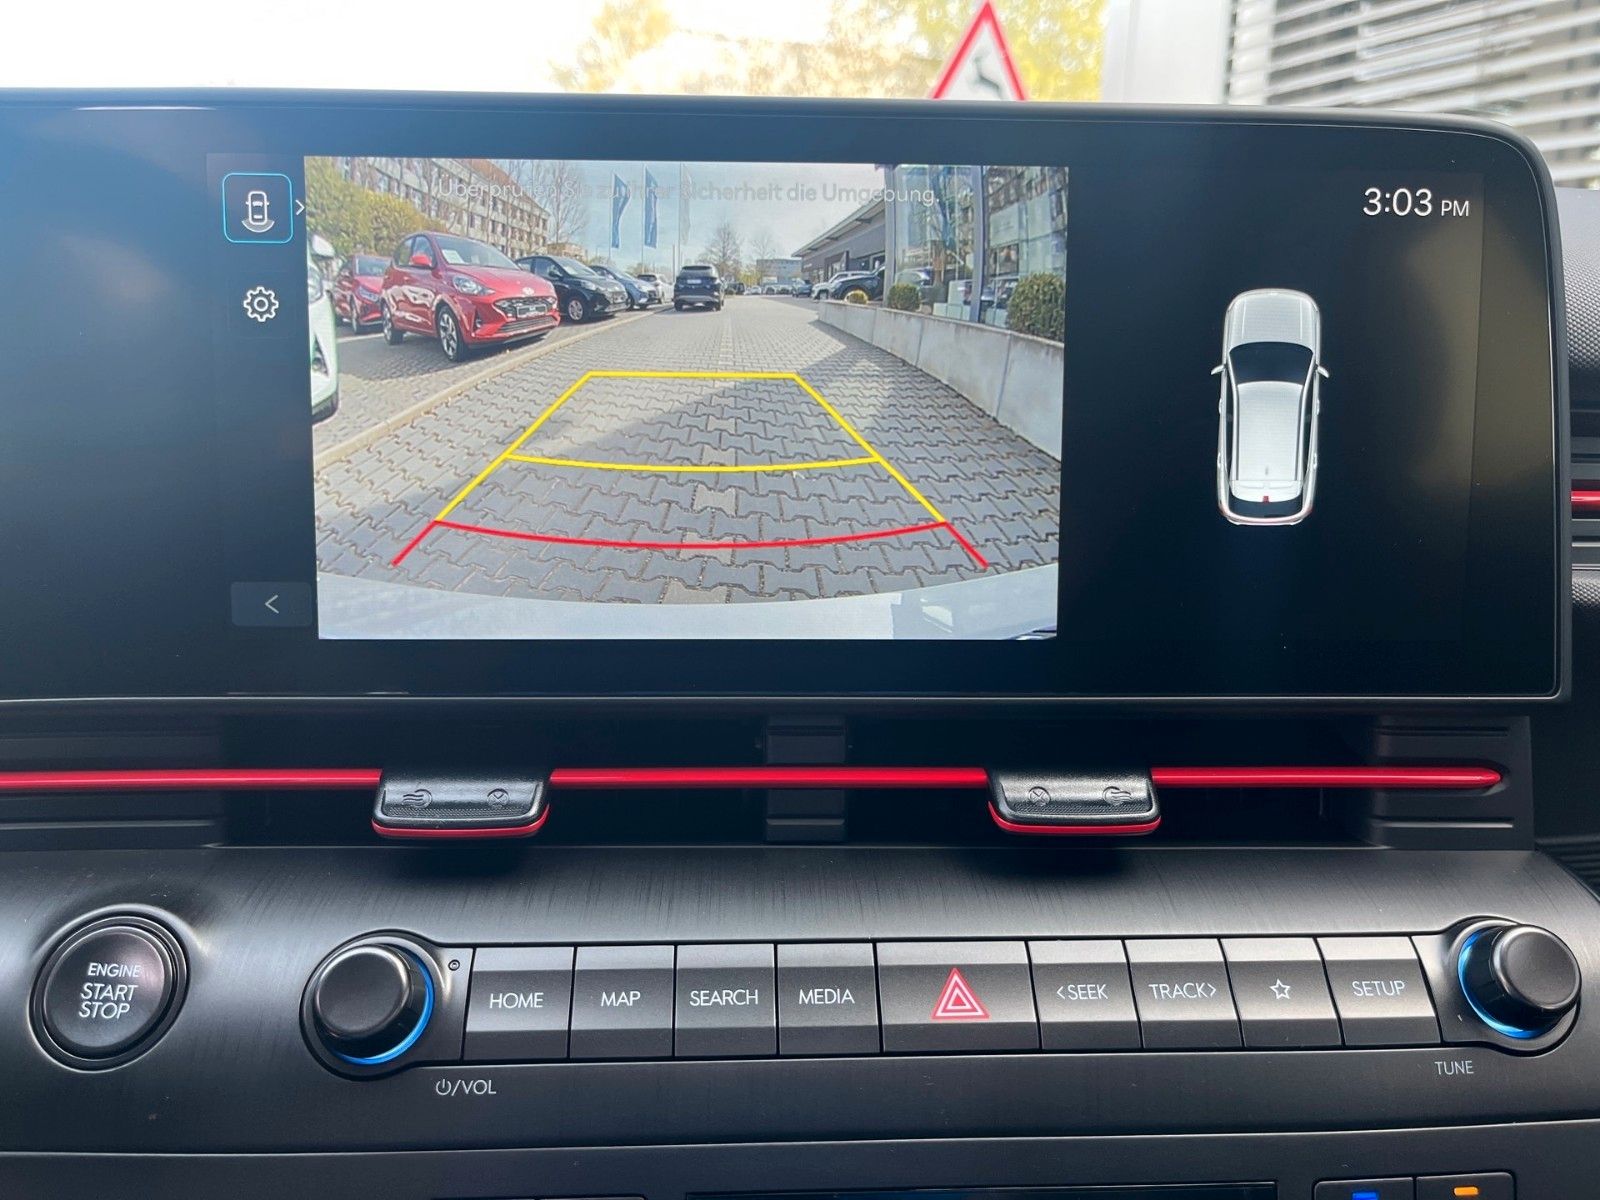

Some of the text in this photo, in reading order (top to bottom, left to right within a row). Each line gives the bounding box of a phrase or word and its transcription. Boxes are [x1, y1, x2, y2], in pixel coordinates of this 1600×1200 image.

[786, 182, 817, 201] die
[1363, 187, 1470, 217] 3:03 PM
[87, 962, 142, 978] ENGINE
[80, 982, 138, 1002] START
[798, 988, 855, 1005] MEDIA
[1352, 980, 1406, 997] SETUP
[489, 992, 544, 1009] HOME
[600, 990, 641, 1007] MAP
[689, 989, 759, 1007] SEARCH
[78, 1001, 131, 1019] STOP
[1434, 1060, 1474, 1075] TUNE
